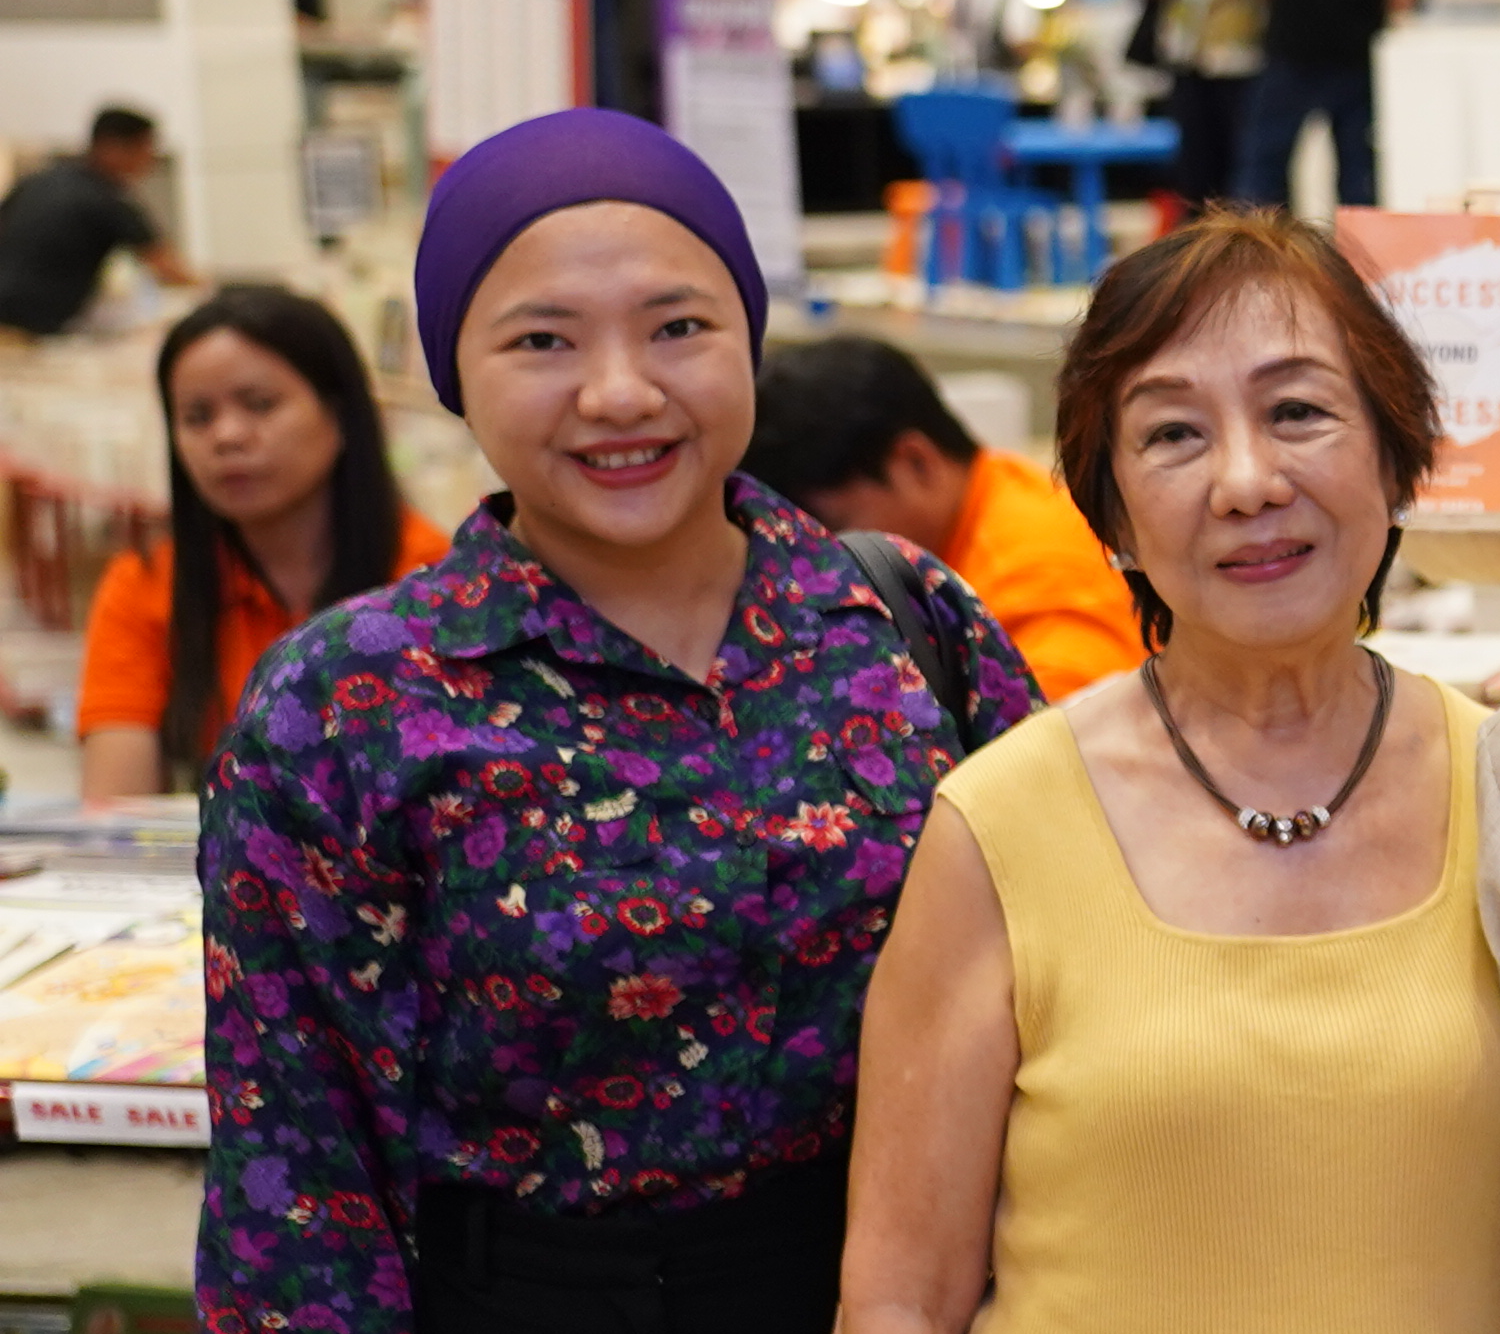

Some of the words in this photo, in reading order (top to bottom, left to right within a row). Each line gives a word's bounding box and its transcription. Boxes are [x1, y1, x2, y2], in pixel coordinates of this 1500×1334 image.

[1426, 344, 1478, 363] YOND
[31, 1101, 103, 1124] SALE
[126, 1107, 199, 1131] SALE
